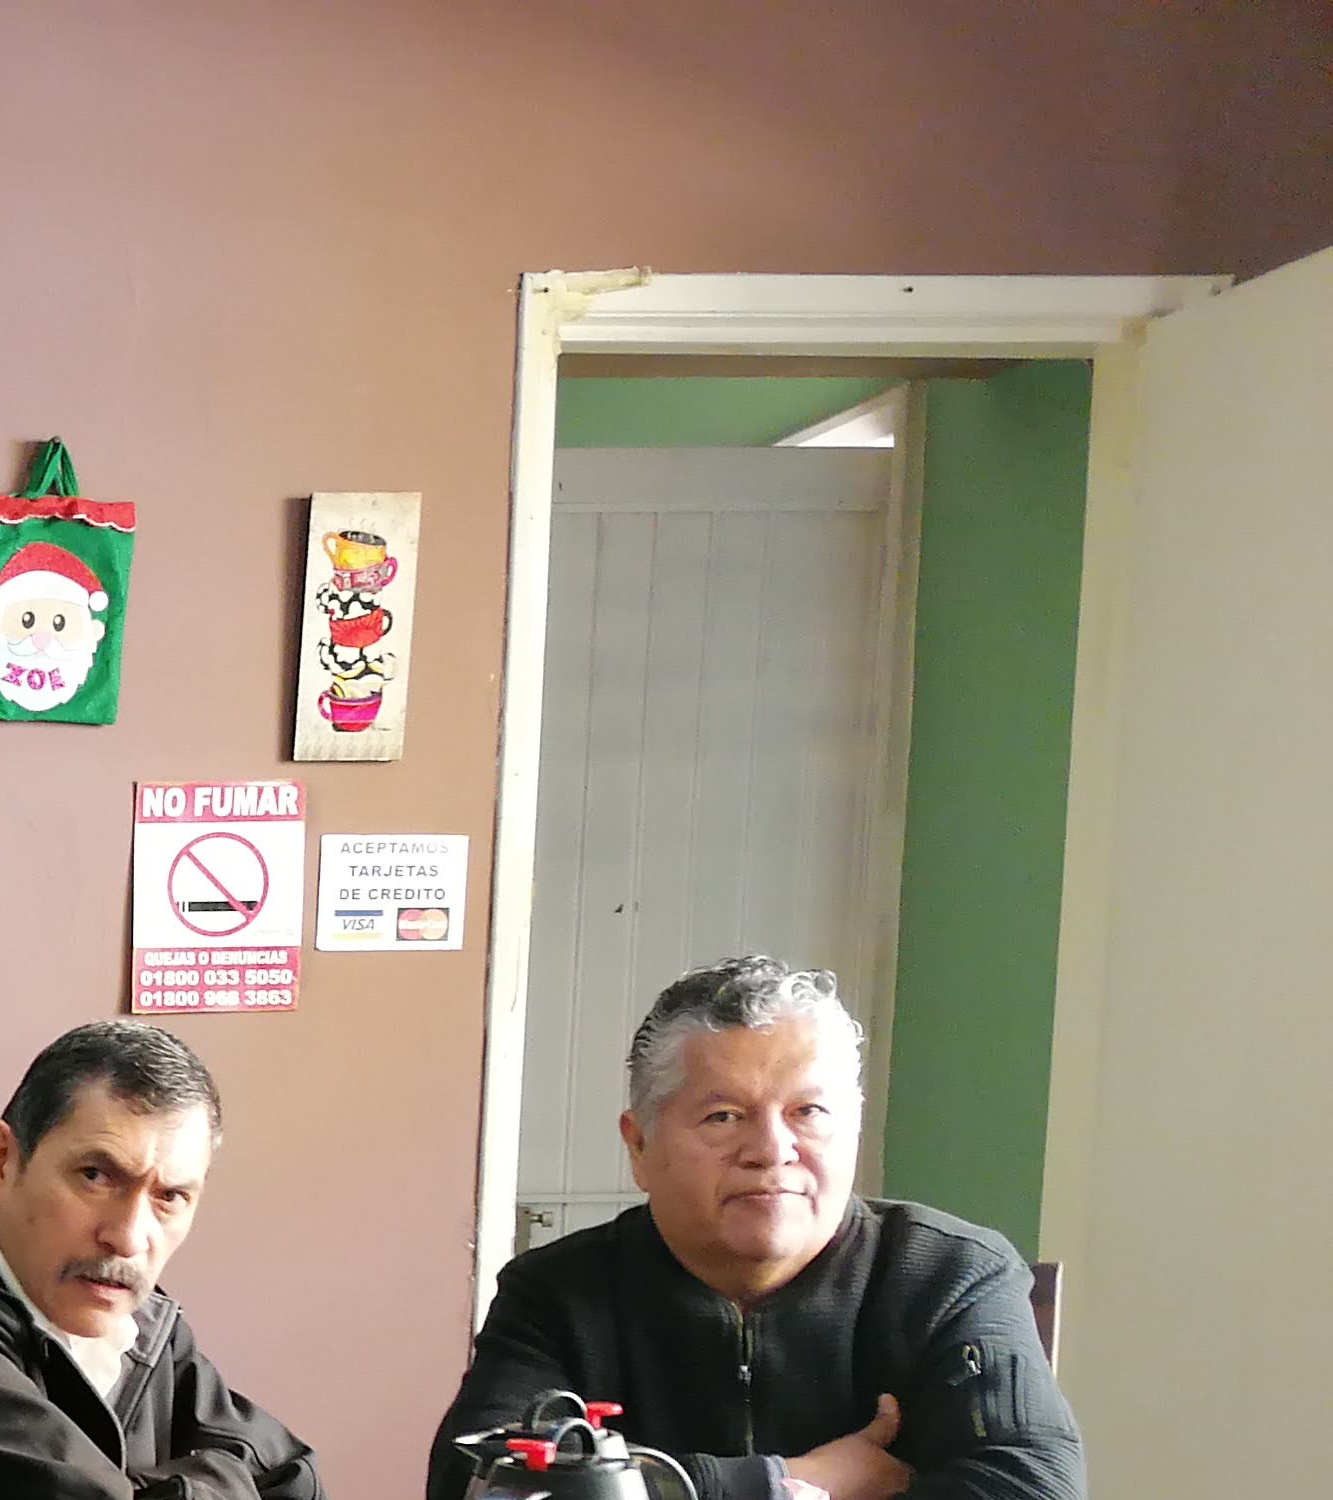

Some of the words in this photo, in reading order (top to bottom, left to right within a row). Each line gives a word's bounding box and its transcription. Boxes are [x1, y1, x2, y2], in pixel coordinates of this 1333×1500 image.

[0, 662, 66, 691] ZOE
[141, 787, 186, 818] NO
[194, 785, 299, 817] FUMAR
[340, 842, 451, 855] ACEPTAMOS
[349, 865, 439, 877] TARJETAS
[339, 887, 361, 900] DE
[368, 887, 446, 900] CREDITO
[341, 918, 375, 931] VISA
[144, 951, 196, 966] QUEJAS
[198, 951, 209, 965] O
[211, 950, 288, 966] DENUNCIAS
[139, 970, 200, 986] 01800
[203, 969, 240, 986] 033
[244, 969, 293, 985] 5050
[139, 990, 200, 1007] 01800
[244, 989, 293, 1006] 3863
